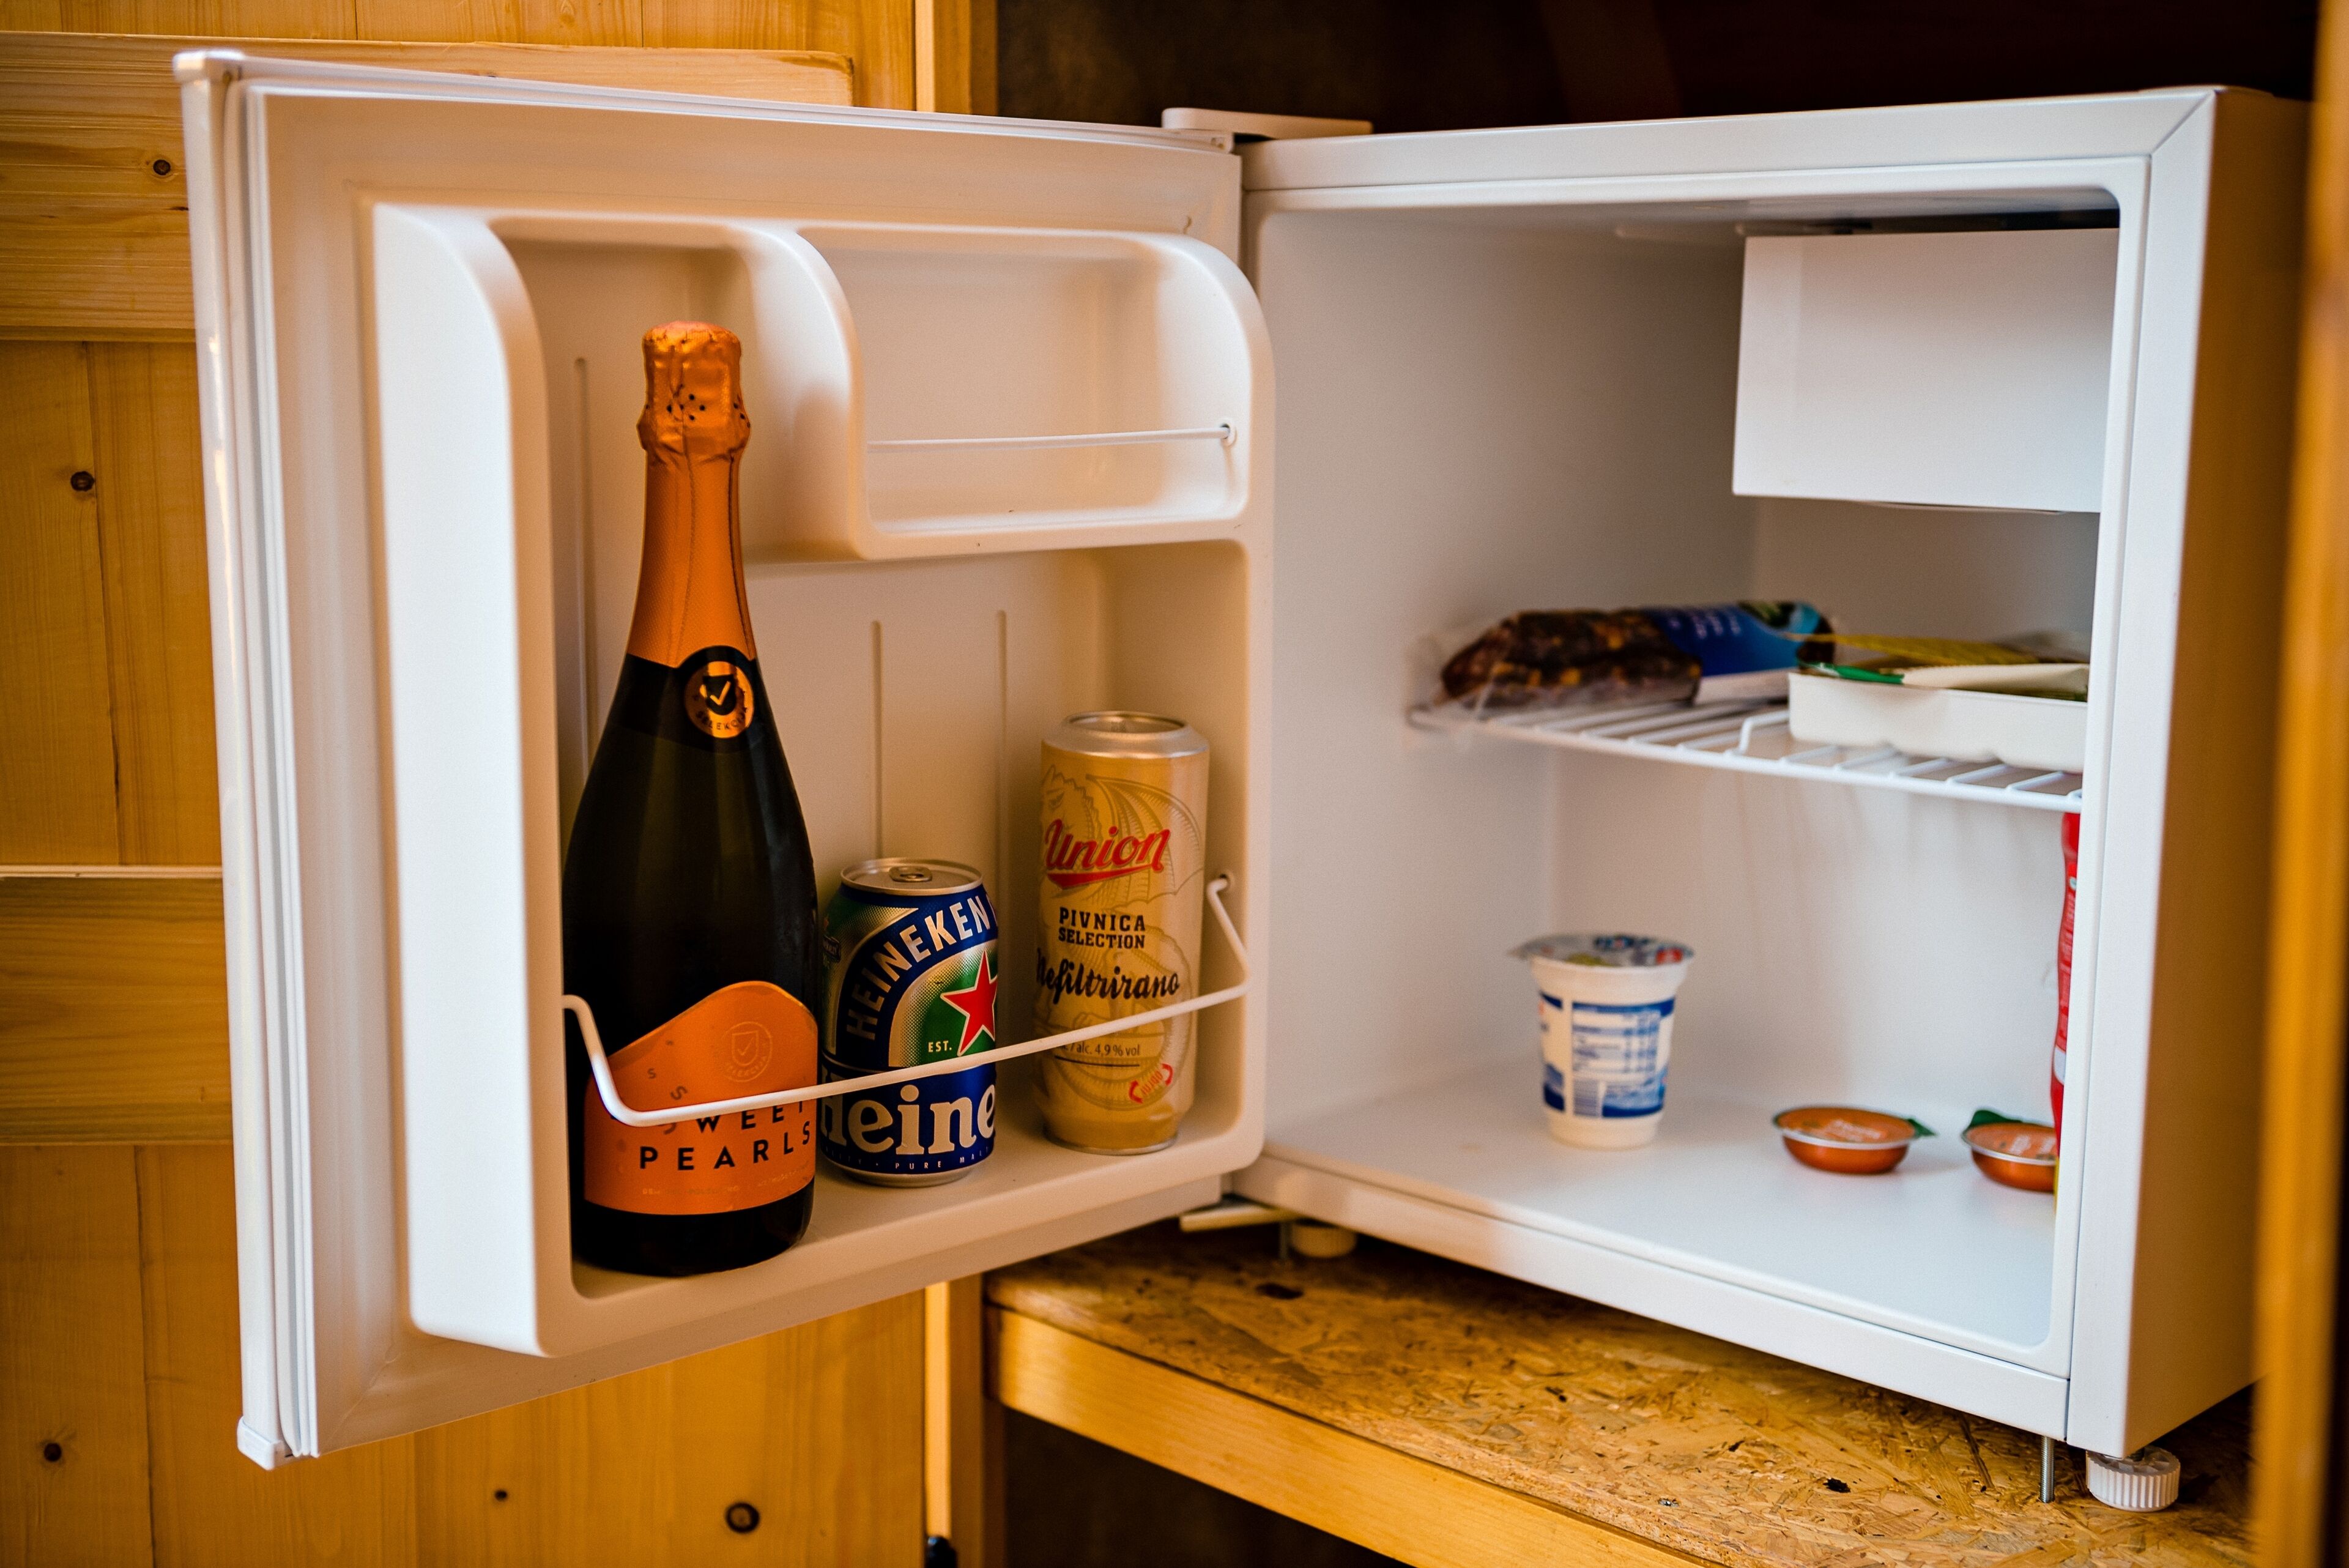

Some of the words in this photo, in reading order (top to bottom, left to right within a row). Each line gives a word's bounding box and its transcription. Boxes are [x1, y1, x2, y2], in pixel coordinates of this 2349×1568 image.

[1044, 819, 1170, 873] Union
[1059, 907, 1146, 931] PIVNICA
[1058, 927, 1146, 949] SELECTION
[846, 895, 991, 1039] HEINEKEN
[928, 1040, 952, 1052] EST.
[1077, 1041, 1092, 1054] alc.
[1125, 1044, 1140, 1057] vol
[640, 1121, 811, 1171] PEARLS
[895, 1161, 941, 1170] PURE
